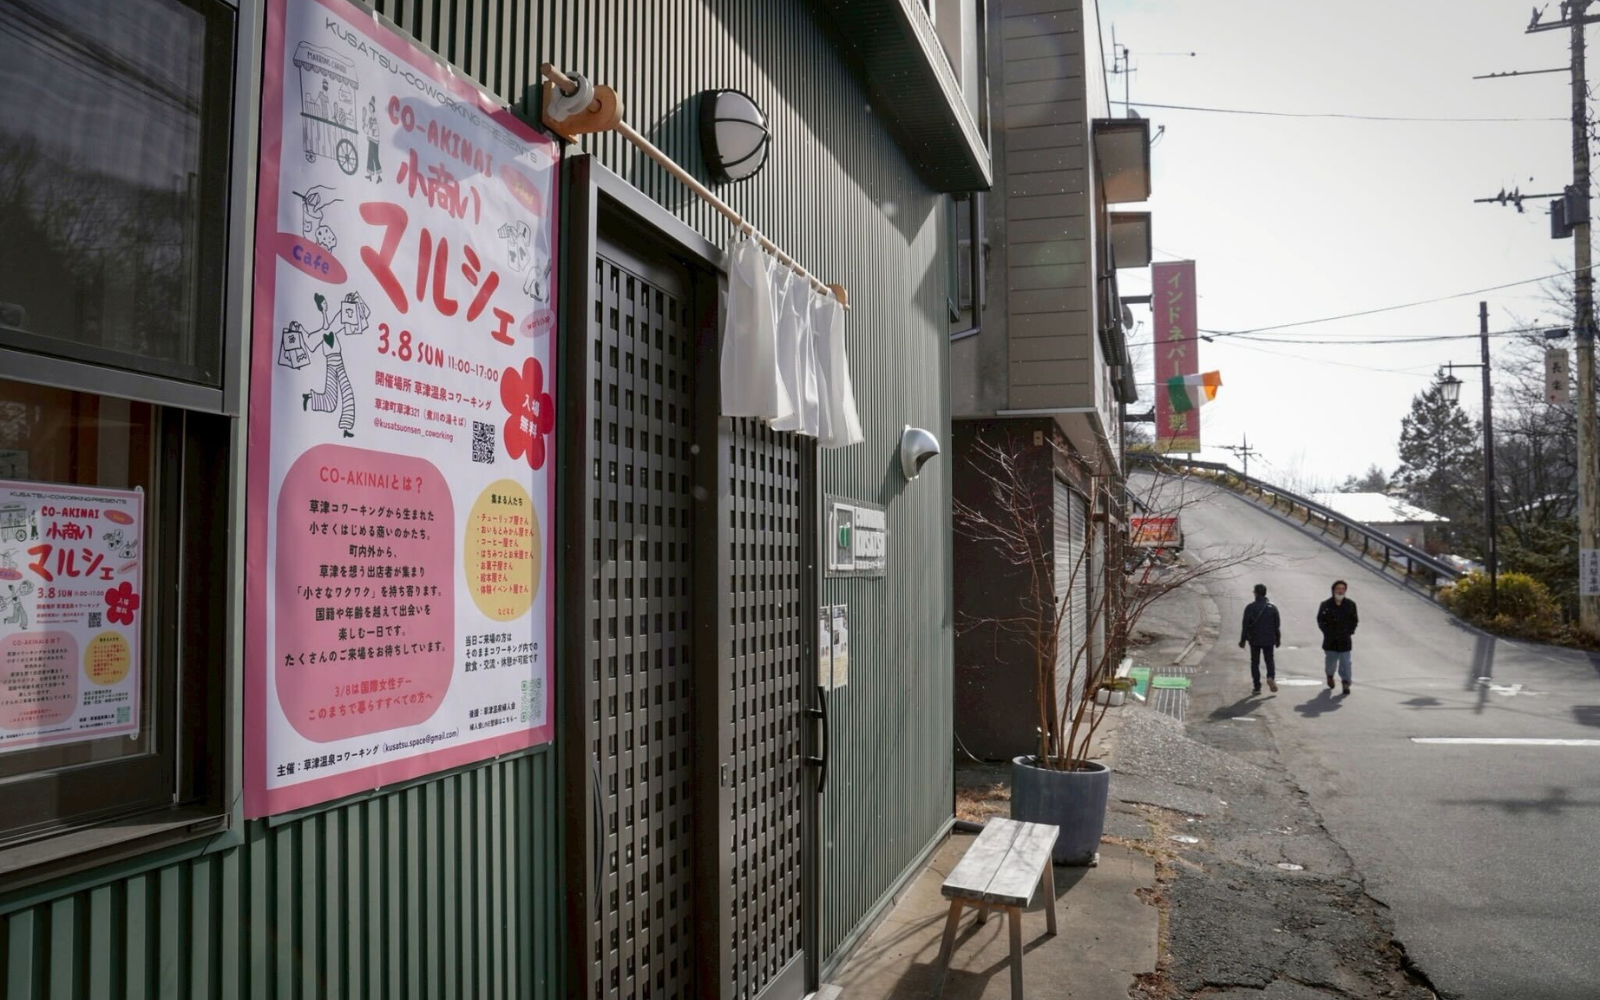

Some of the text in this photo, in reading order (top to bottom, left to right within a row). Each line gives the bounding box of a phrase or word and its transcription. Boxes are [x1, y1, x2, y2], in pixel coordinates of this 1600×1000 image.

[388, 95, 493, 179] CO-AKINAI
[396, 147, 482, 225] 小商い
[358, 201, 516, 347] マルシェ
[377, 322, 413, 362] 3.8
[417, 342, 444, 368] SUN
[374, 370, 492, 411] 開催場所 草津温泉コワーキング
[522, 393, 540, 417] 入場
[519, 414, 538, 440] 無料
[308, 499, 435, 522] 草津コワーキングから生まれた
[491, 493, 523, 507] 集まる人たち
[41, 505, 100, 520] CO-AKINAI
[45, 521, 94, 541] 小商い
[27, 543, 115, 582] マルシェ
[318, 564, 426, 579] 草津を想う出店者が集まり
[37, 587, 56, 600] 3.8
[57, 590, 73, 598] SUN
[315, 603, 432, 622] 国籍や年齢を越えて出会いを
